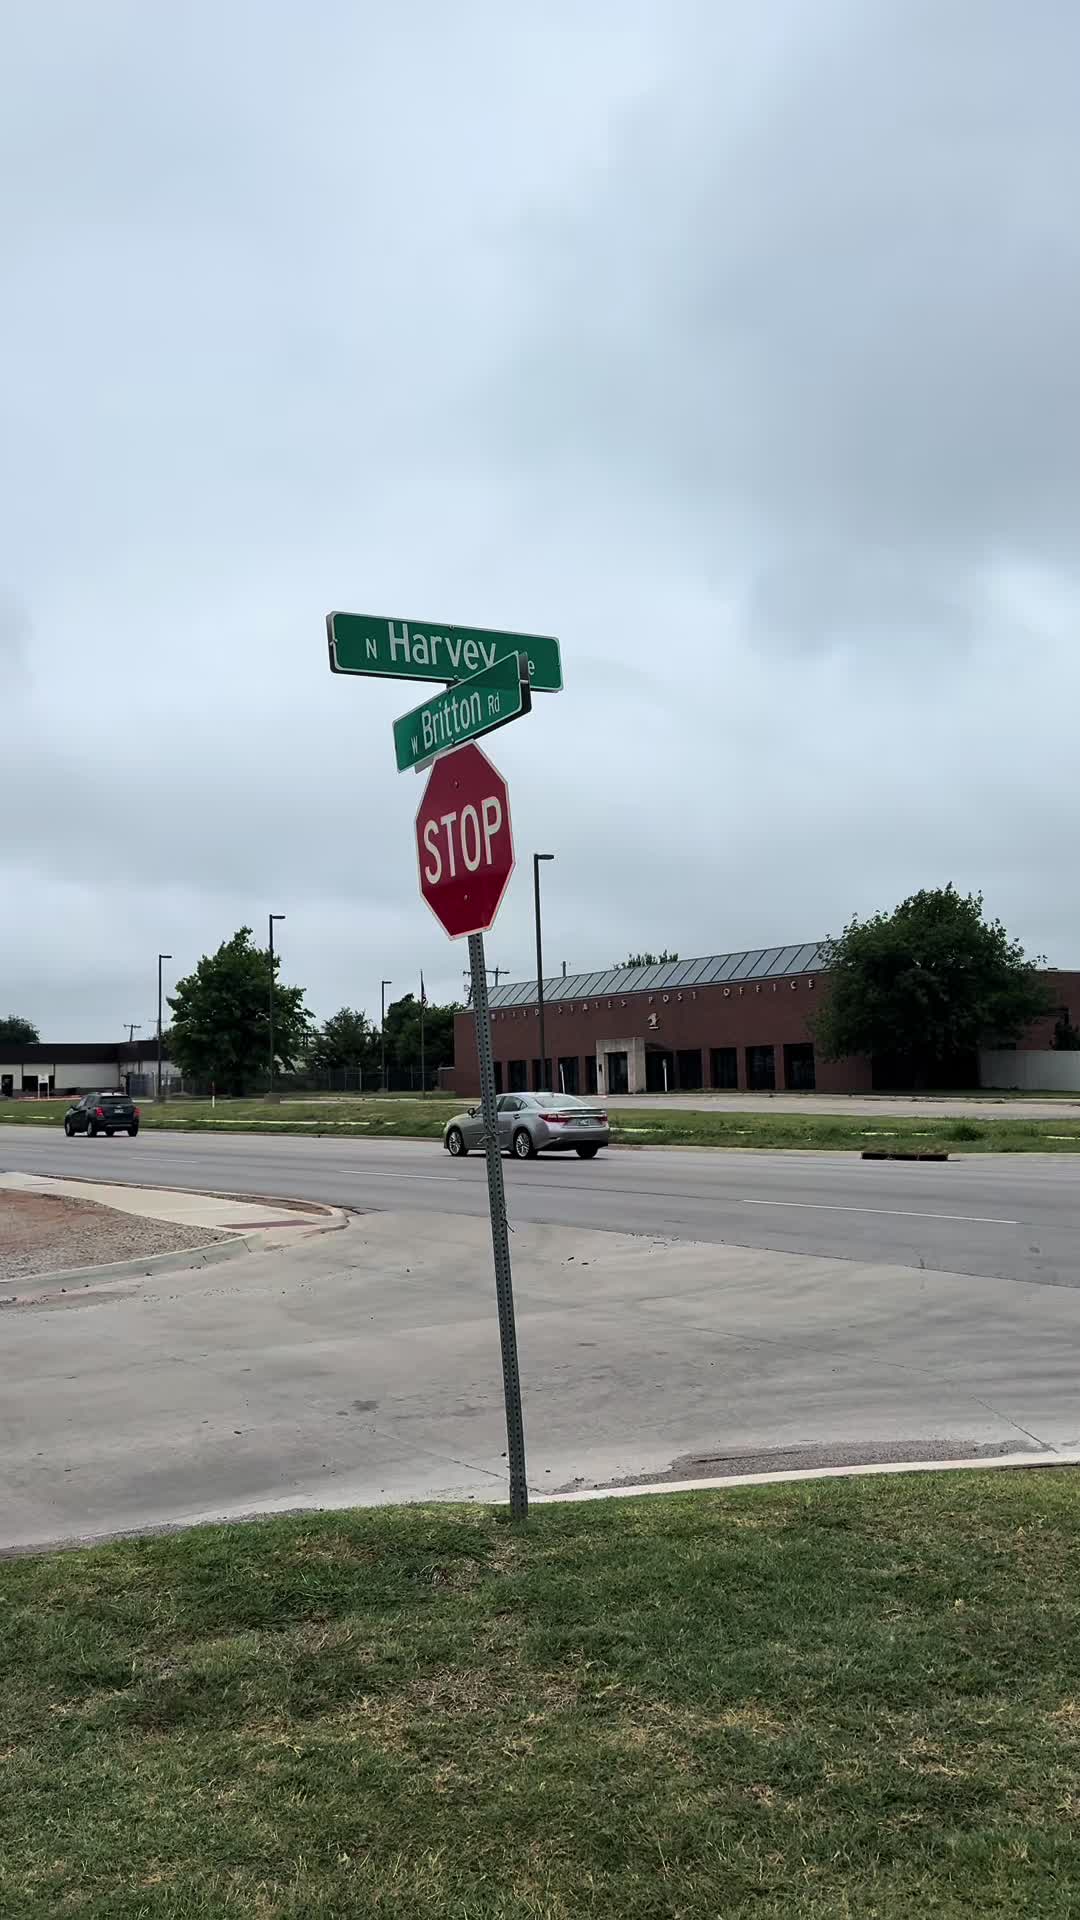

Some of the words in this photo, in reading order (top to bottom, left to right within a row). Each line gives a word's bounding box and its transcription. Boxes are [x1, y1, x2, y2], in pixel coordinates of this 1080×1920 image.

[366, 638, 378, 660] N
[388, 621, 496, 669] Harvey
[411, 735, 419, 755] W
[422, 691, 482, 749] Britton
[488, 692, 500, 714] Rd
[423, 796, 502, 884] STOP
[490, 1008, 540, 1020] NITED
[558, 1000, 627, 1014] STATES
[649, 991, 697, 1005] POST
[723, 979, 815, 997] OFFICE
